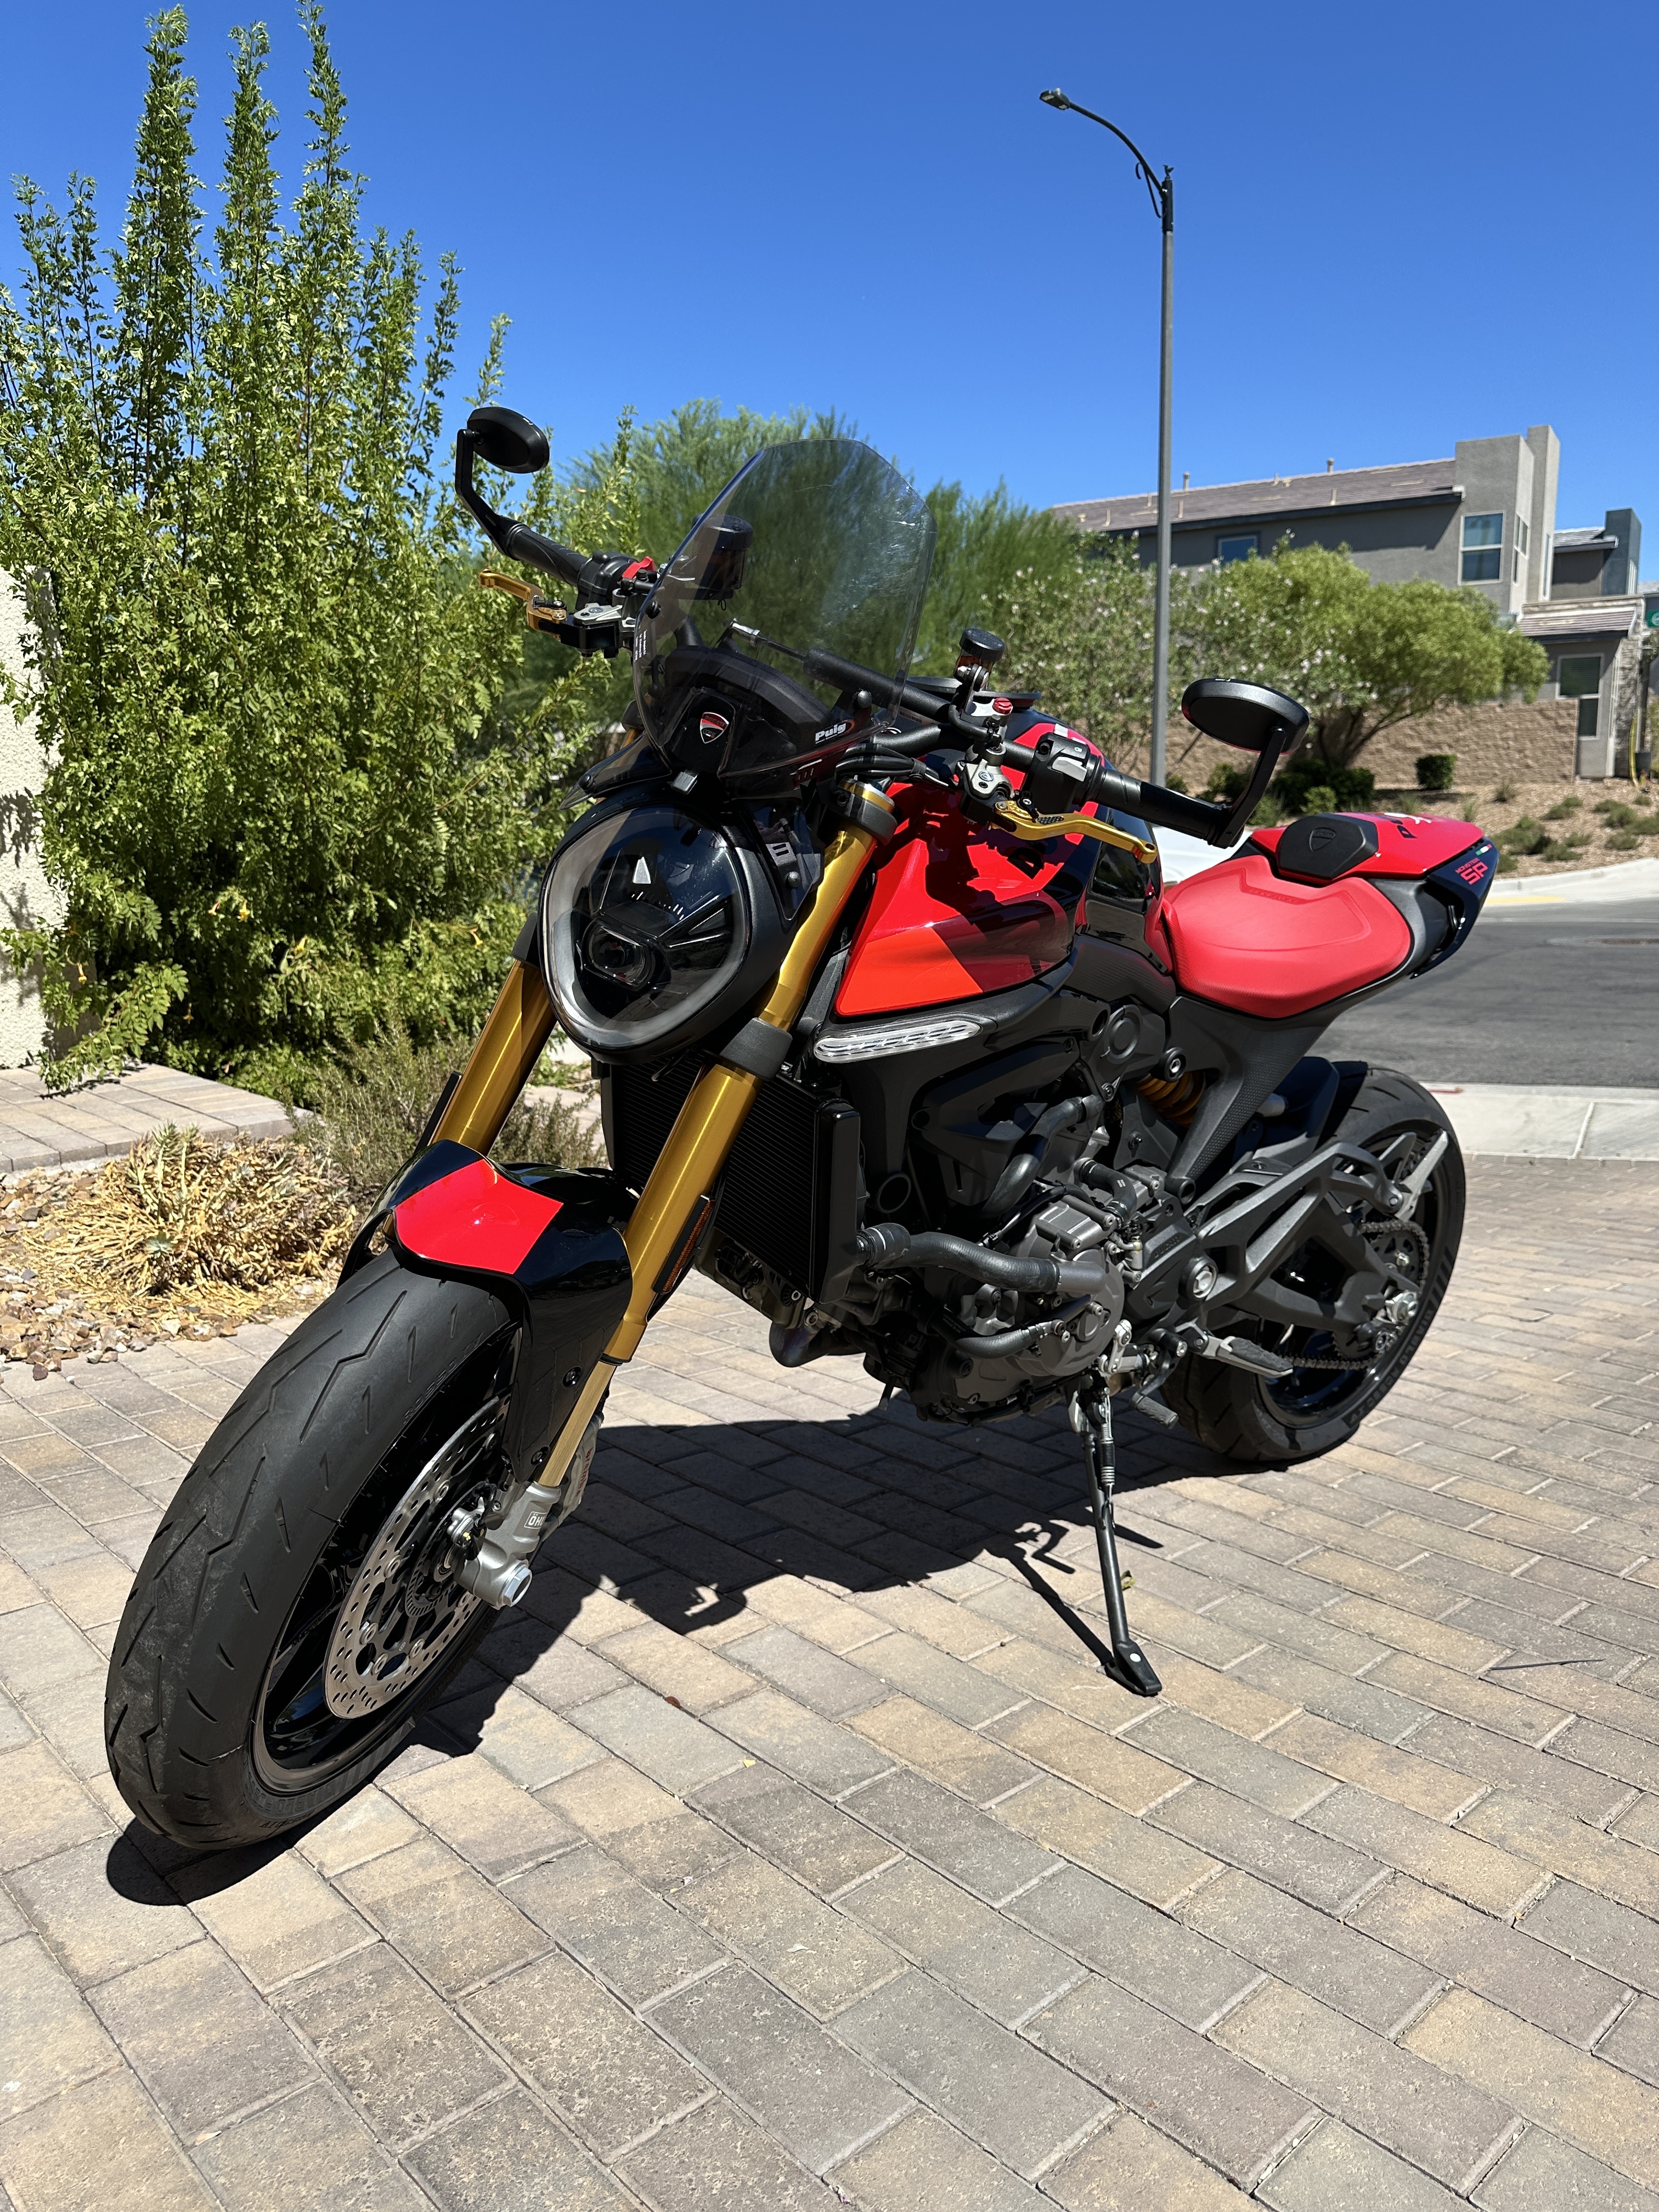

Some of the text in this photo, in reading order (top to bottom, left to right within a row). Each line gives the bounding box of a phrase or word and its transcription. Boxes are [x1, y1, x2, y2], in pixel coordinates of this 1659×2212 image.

[815, 723, 846, 741] Puig
[1461, 861, 1488, 885] SP
[575, 1447, 594, 1497] brembo
